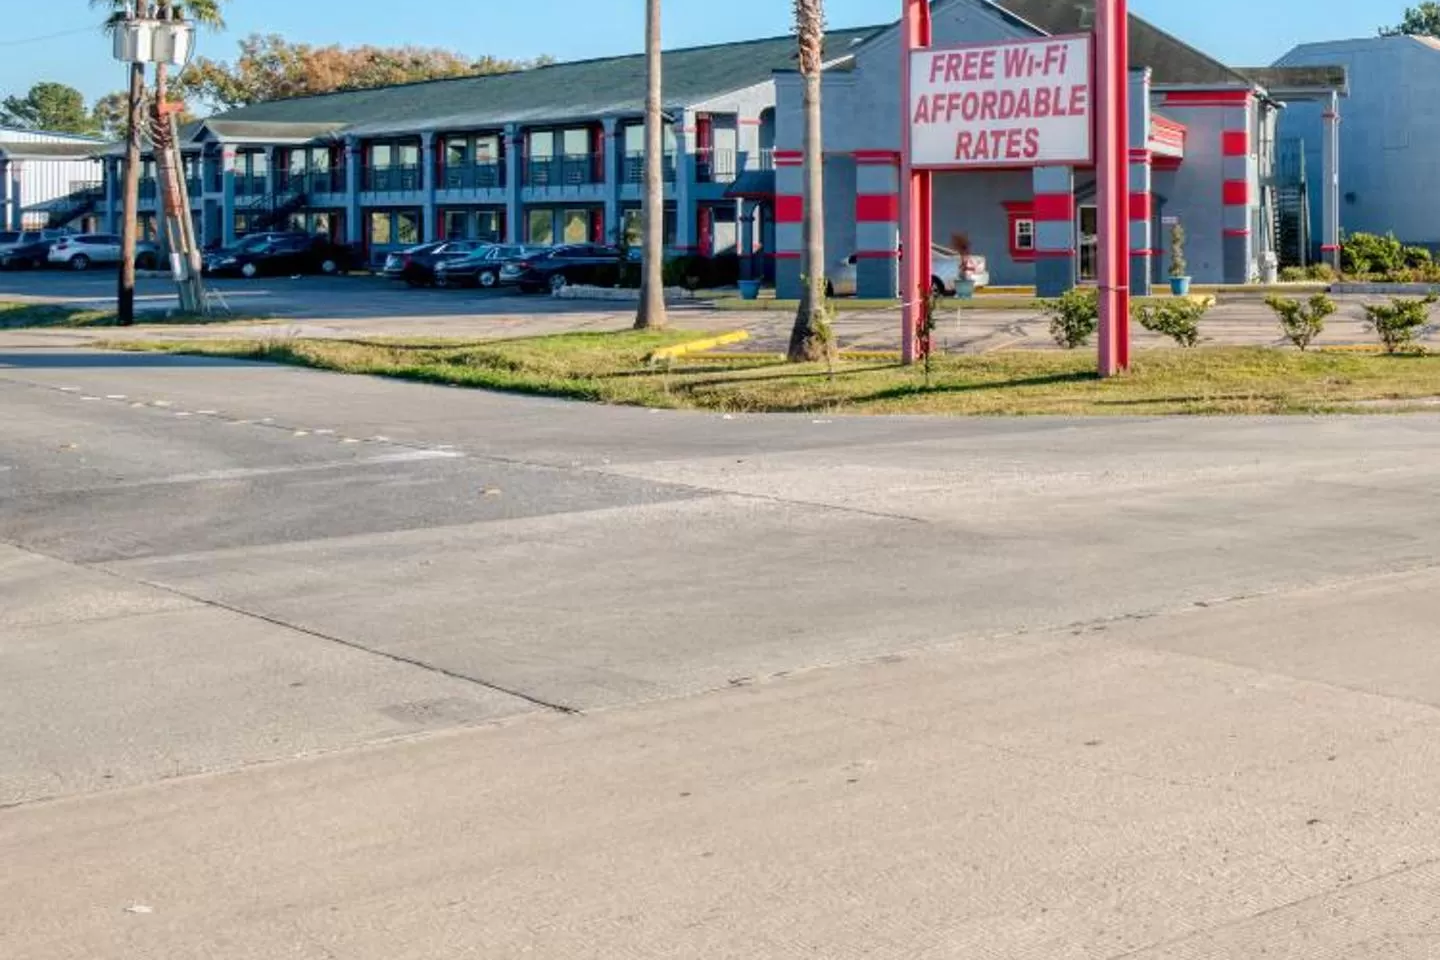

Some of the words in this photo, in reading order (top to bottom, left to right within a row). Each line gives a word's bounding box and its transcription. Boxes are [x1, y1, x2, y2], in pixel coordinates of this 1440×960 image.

[929, 50, 996, 83] FREE
[1004, 43, 1068, 78] Wi-Fi
[913, 84, 1087, 124] AFFORDABLE
[955, 127, 1039, 160] RATES
